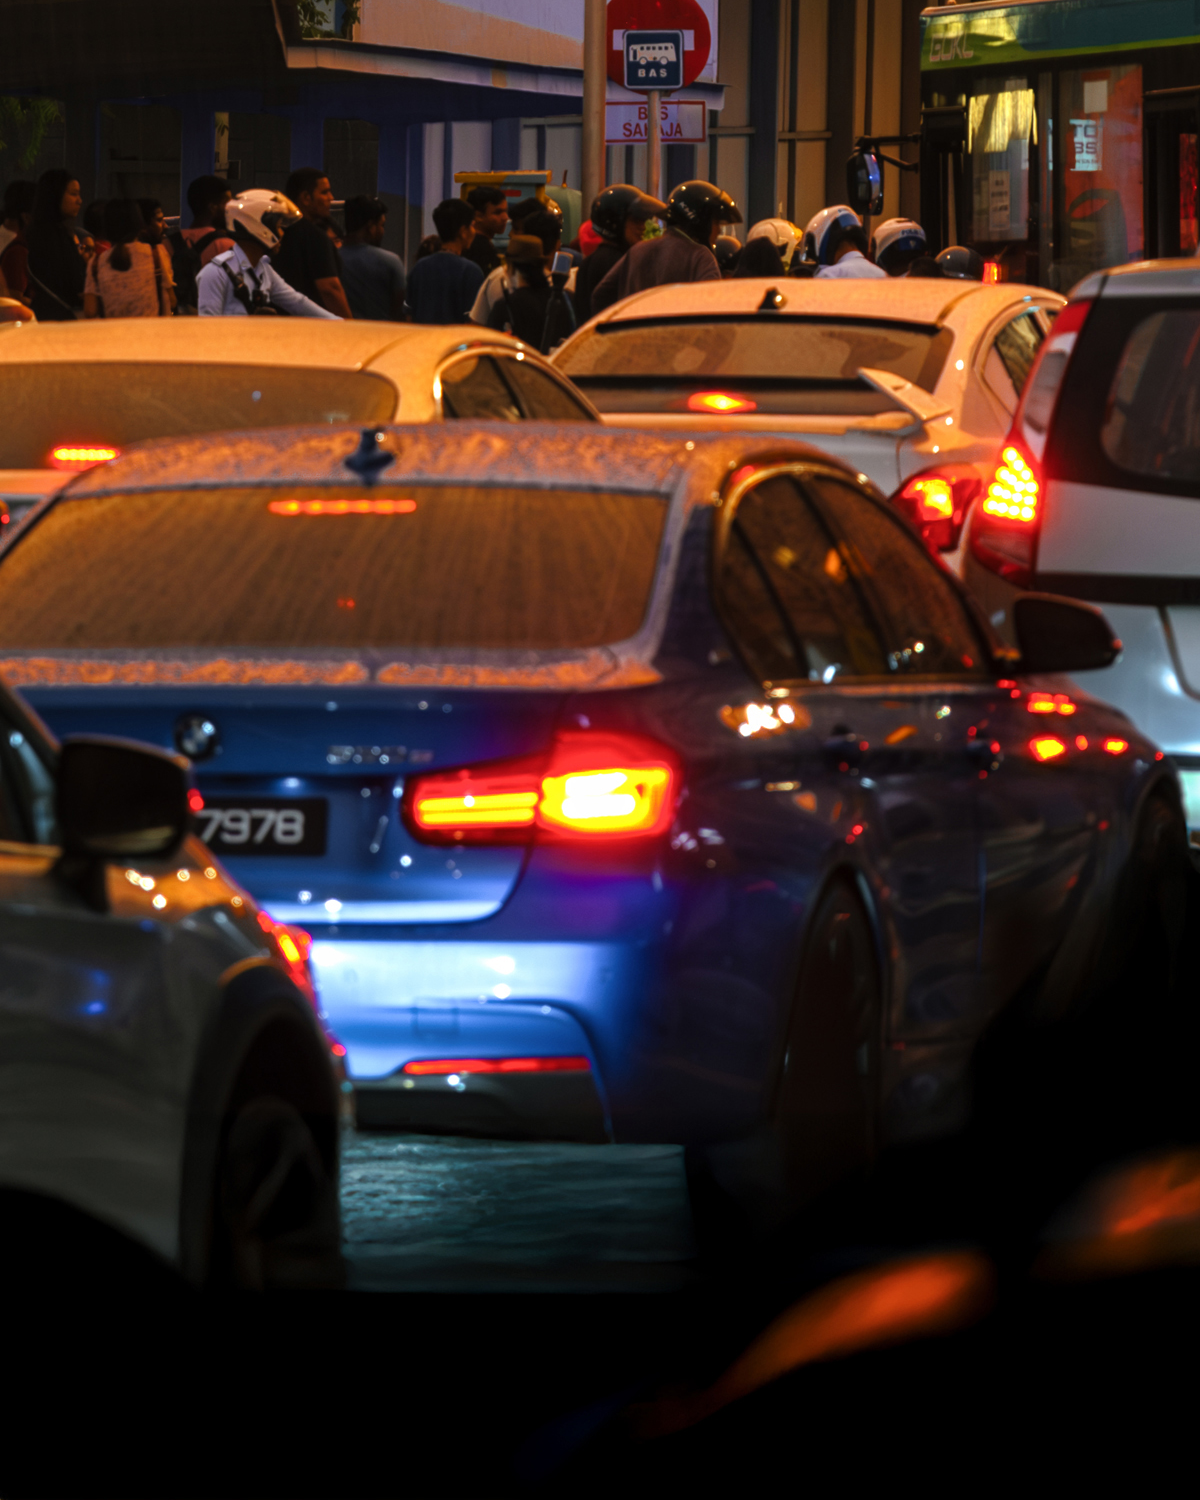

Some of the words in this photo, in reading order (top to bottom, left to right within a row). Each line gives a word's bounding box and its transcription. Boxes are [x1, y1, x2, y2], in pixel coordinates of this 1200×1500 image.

[637, 68, 667, 78] BAS
[637, 106, 669, 120] BS
[195, 808, 306, 845] 7978
